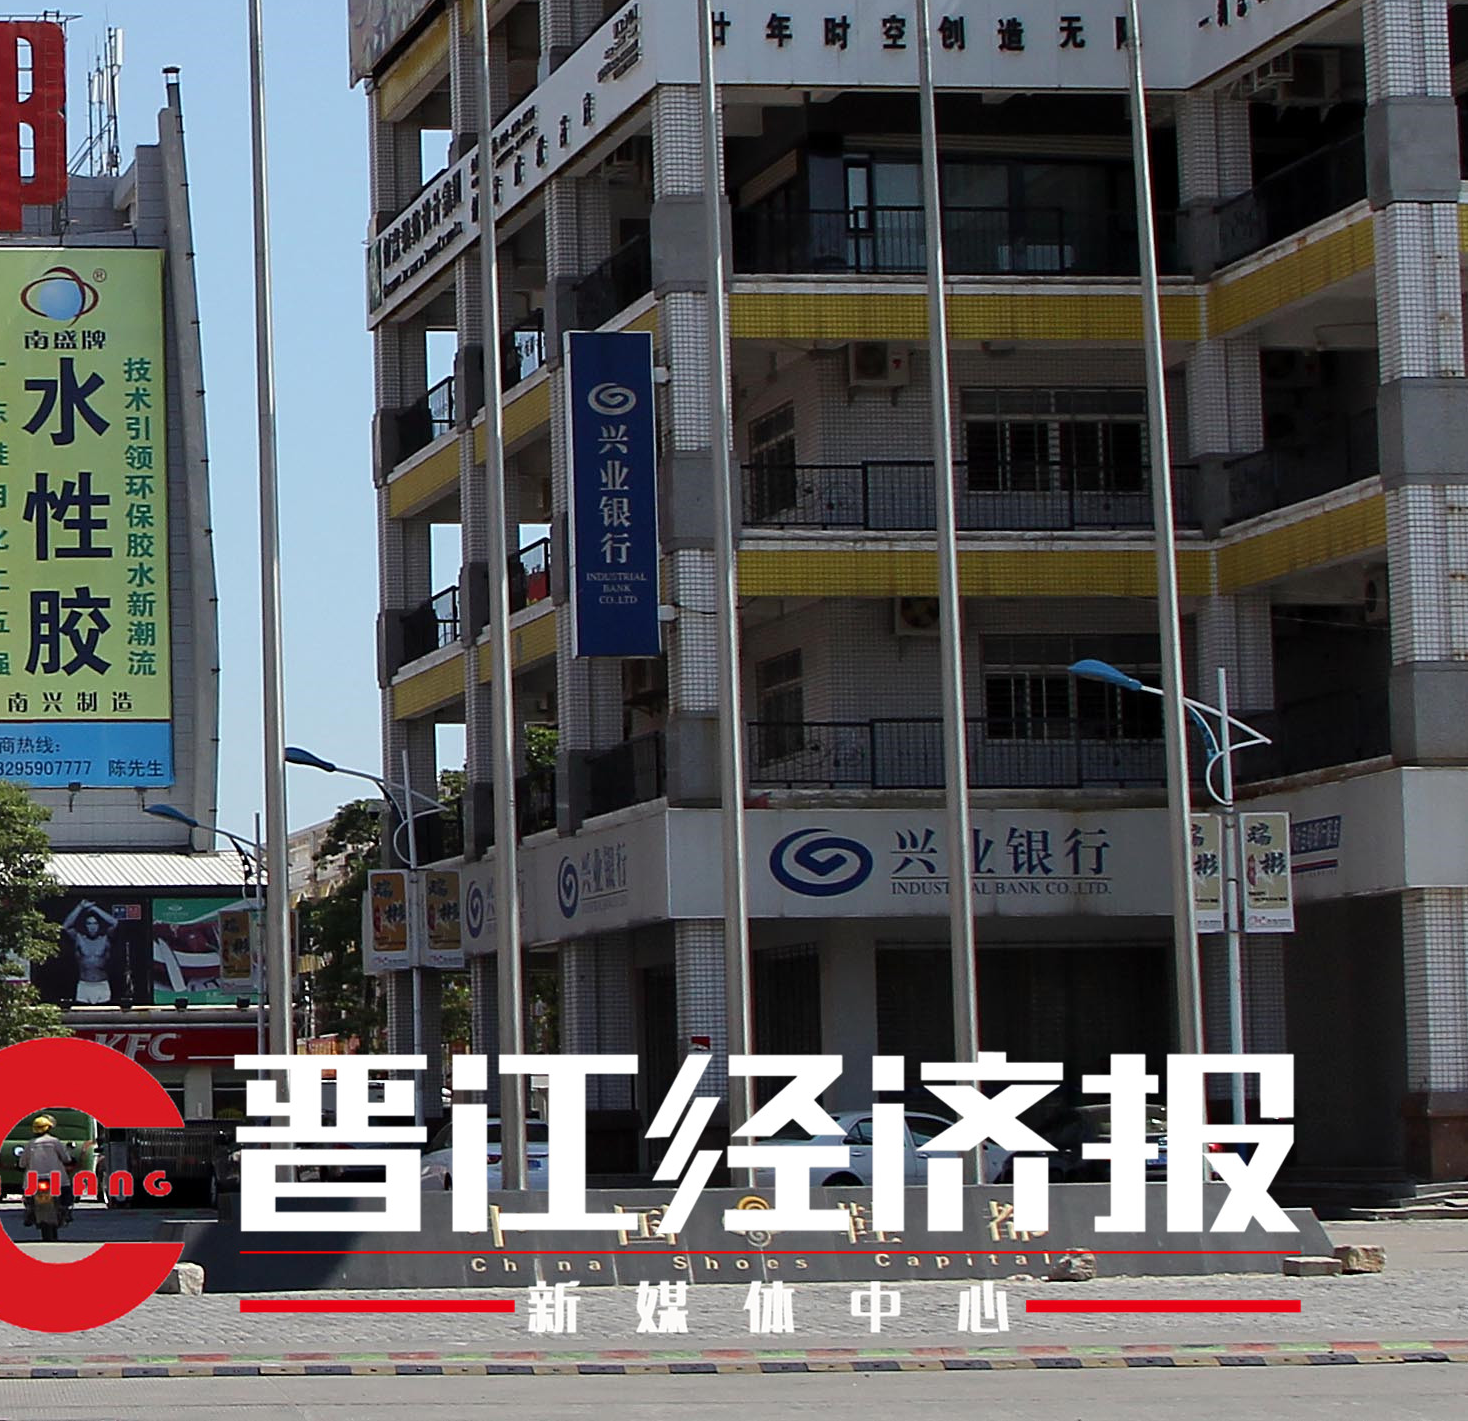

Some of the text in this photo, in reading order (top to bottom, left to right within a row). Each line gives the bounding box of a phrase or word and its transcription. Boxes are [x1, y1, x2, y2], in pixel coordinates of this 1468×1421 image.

[712, 12, 1142, 51] 廿年时空创造无
[22, 330, 107, 351] 南盛牌
[598, 424, 631, 565] 兴业银行
[21, 356, 114, 679] 水性胶
[122, 356, 157, 677] 技术引领环保胶水新潮流
[602, 583, 632, 594] BANK
[7, 690, 134, 714] 南兴制造
[108, 758, 164, 778] 陈先生
[892, 881, 992, 896] INDUSTAL
[996, 881, 1041, 896] BANK
[94, 1032, 179, 1063] KFC
[672, 1254, 809, 1272] Shoes
[874, 1252, 1052, 1270] Capital
